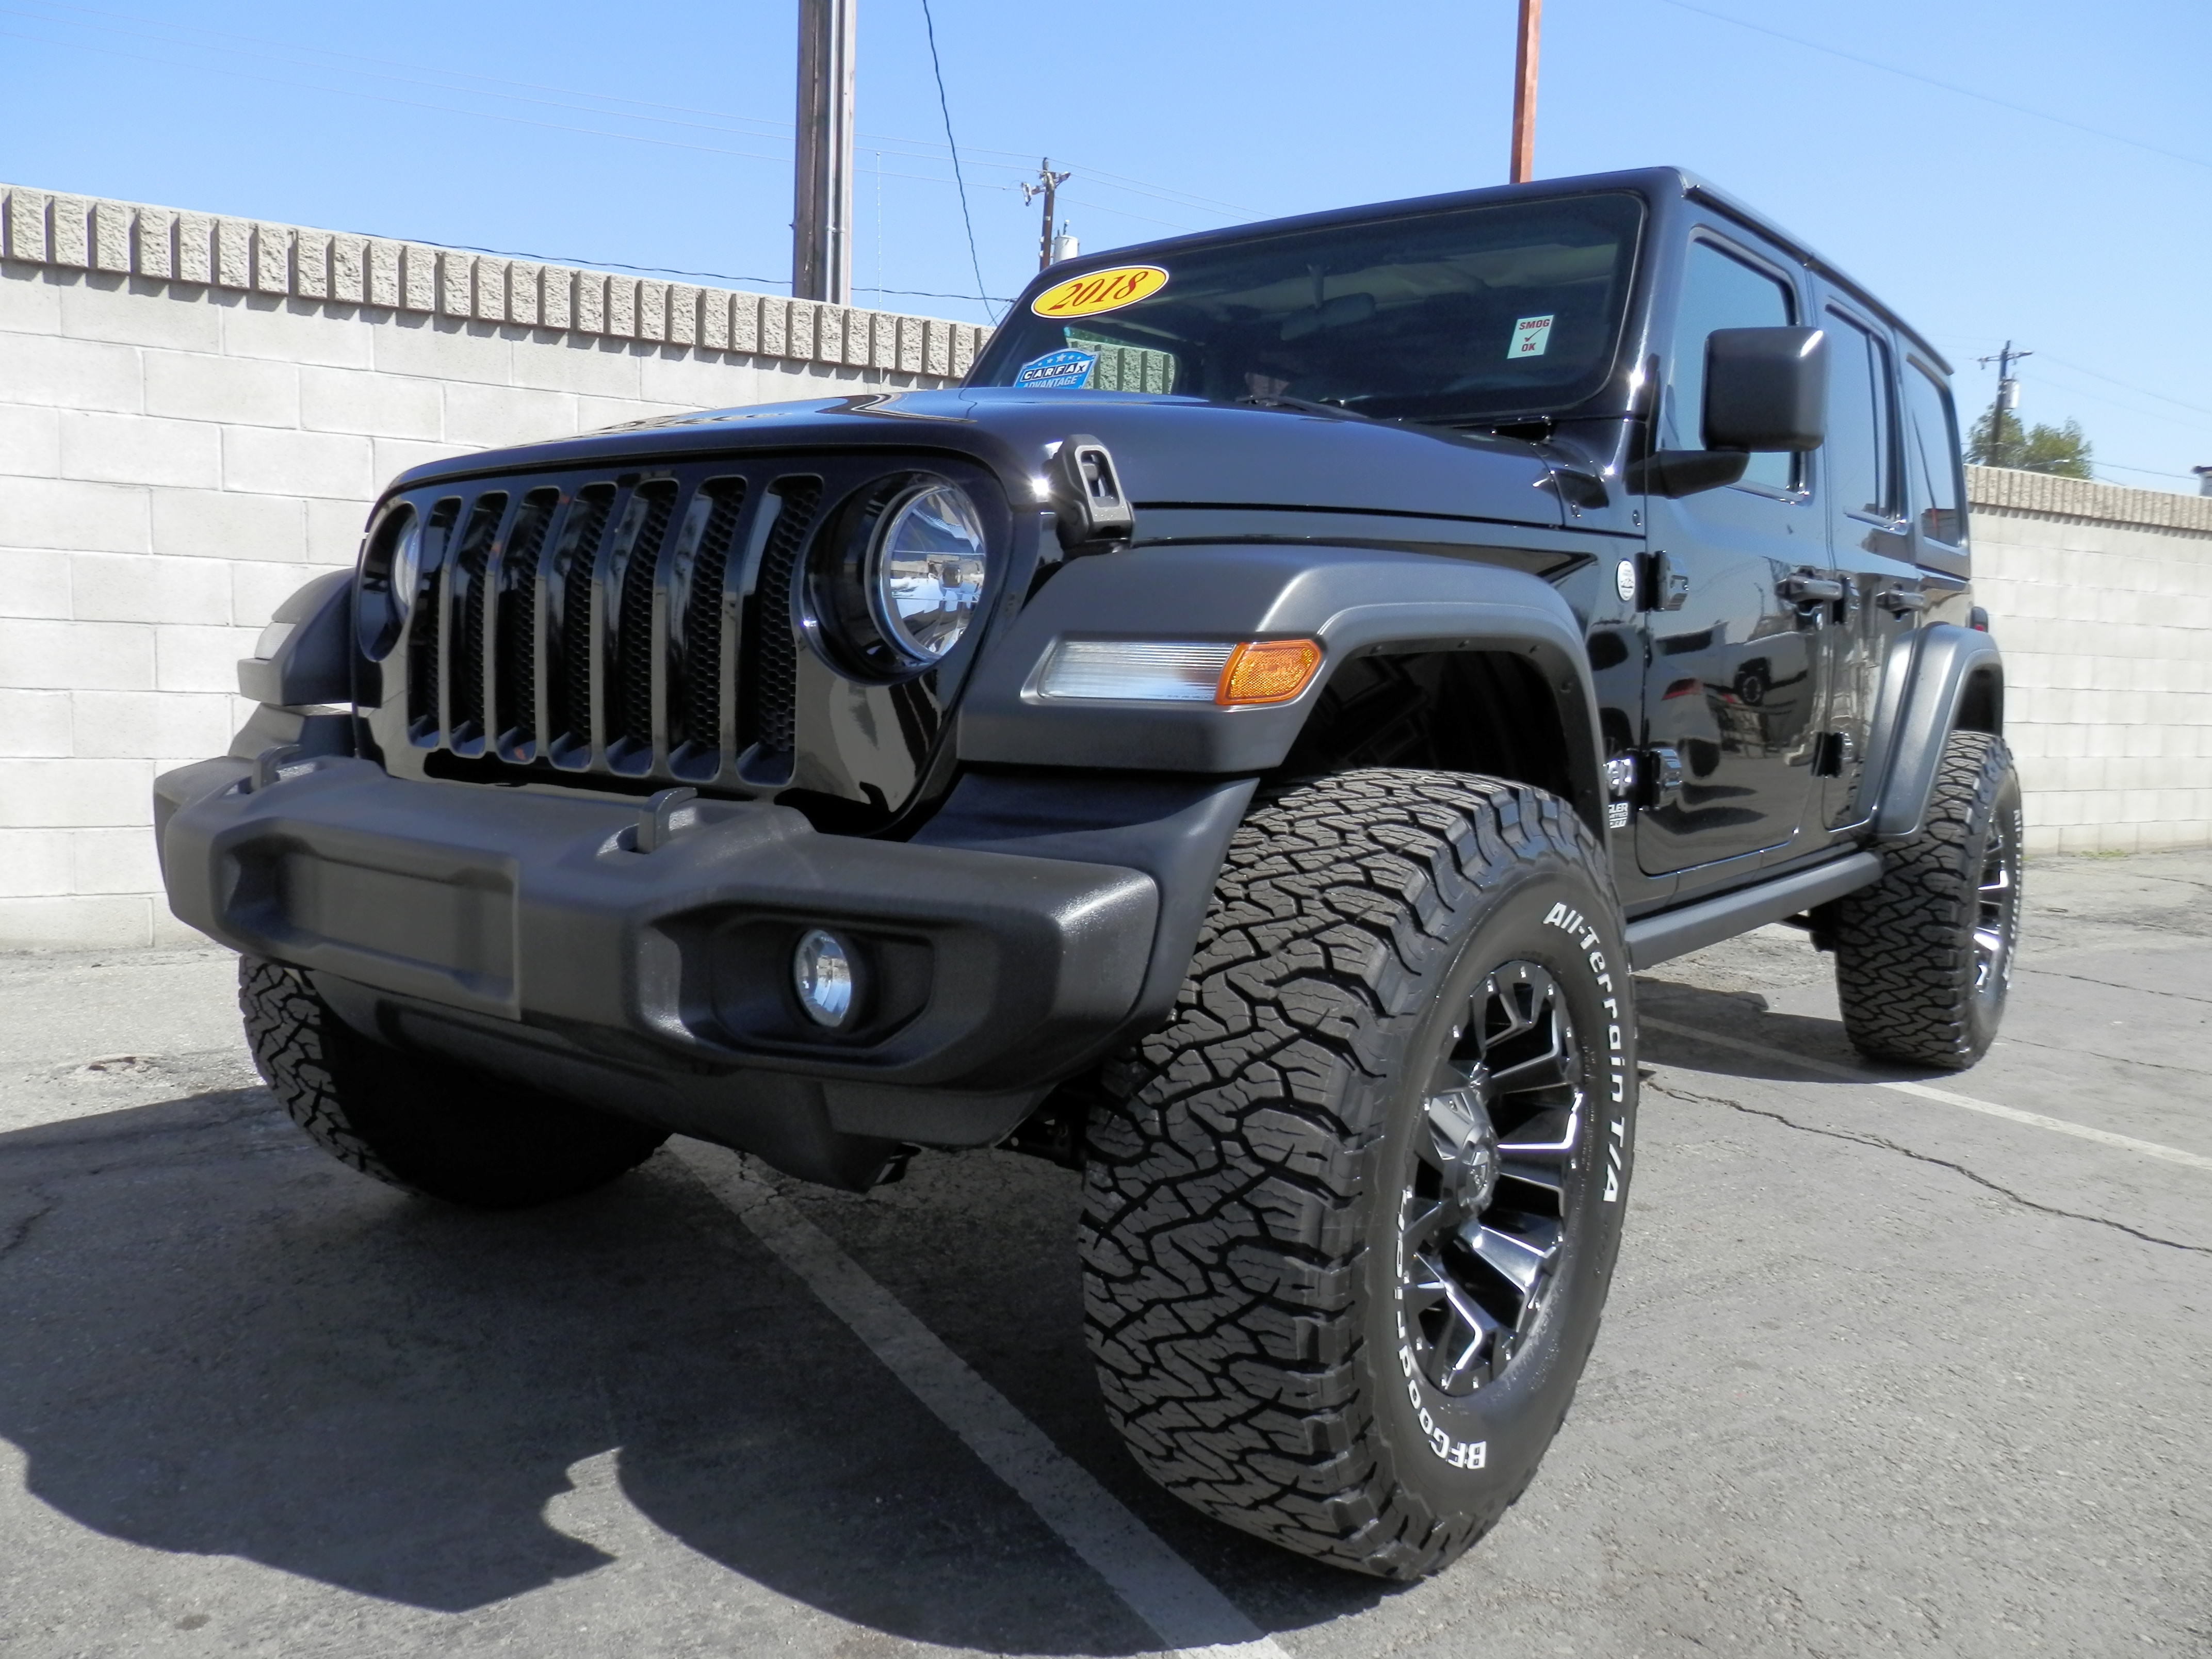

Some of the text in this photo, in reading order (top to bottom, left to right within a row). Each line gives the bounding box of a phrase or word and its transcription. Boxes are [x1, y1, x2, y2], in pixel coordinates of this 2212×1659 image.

[1047, 271, 1149, 311] 2018
[1519, 319, 1551, 330] SMOG
[1521, 343, 1537, 352] OK
[1023, 364, 1086, 380] CARFAX
[1023, 376, 1078, 388] ADVANTAGE
[1543, 902, 1625, 1202] All-Terrain T/A
[1394, 1190, 1486, 1470] BFGoodrich
